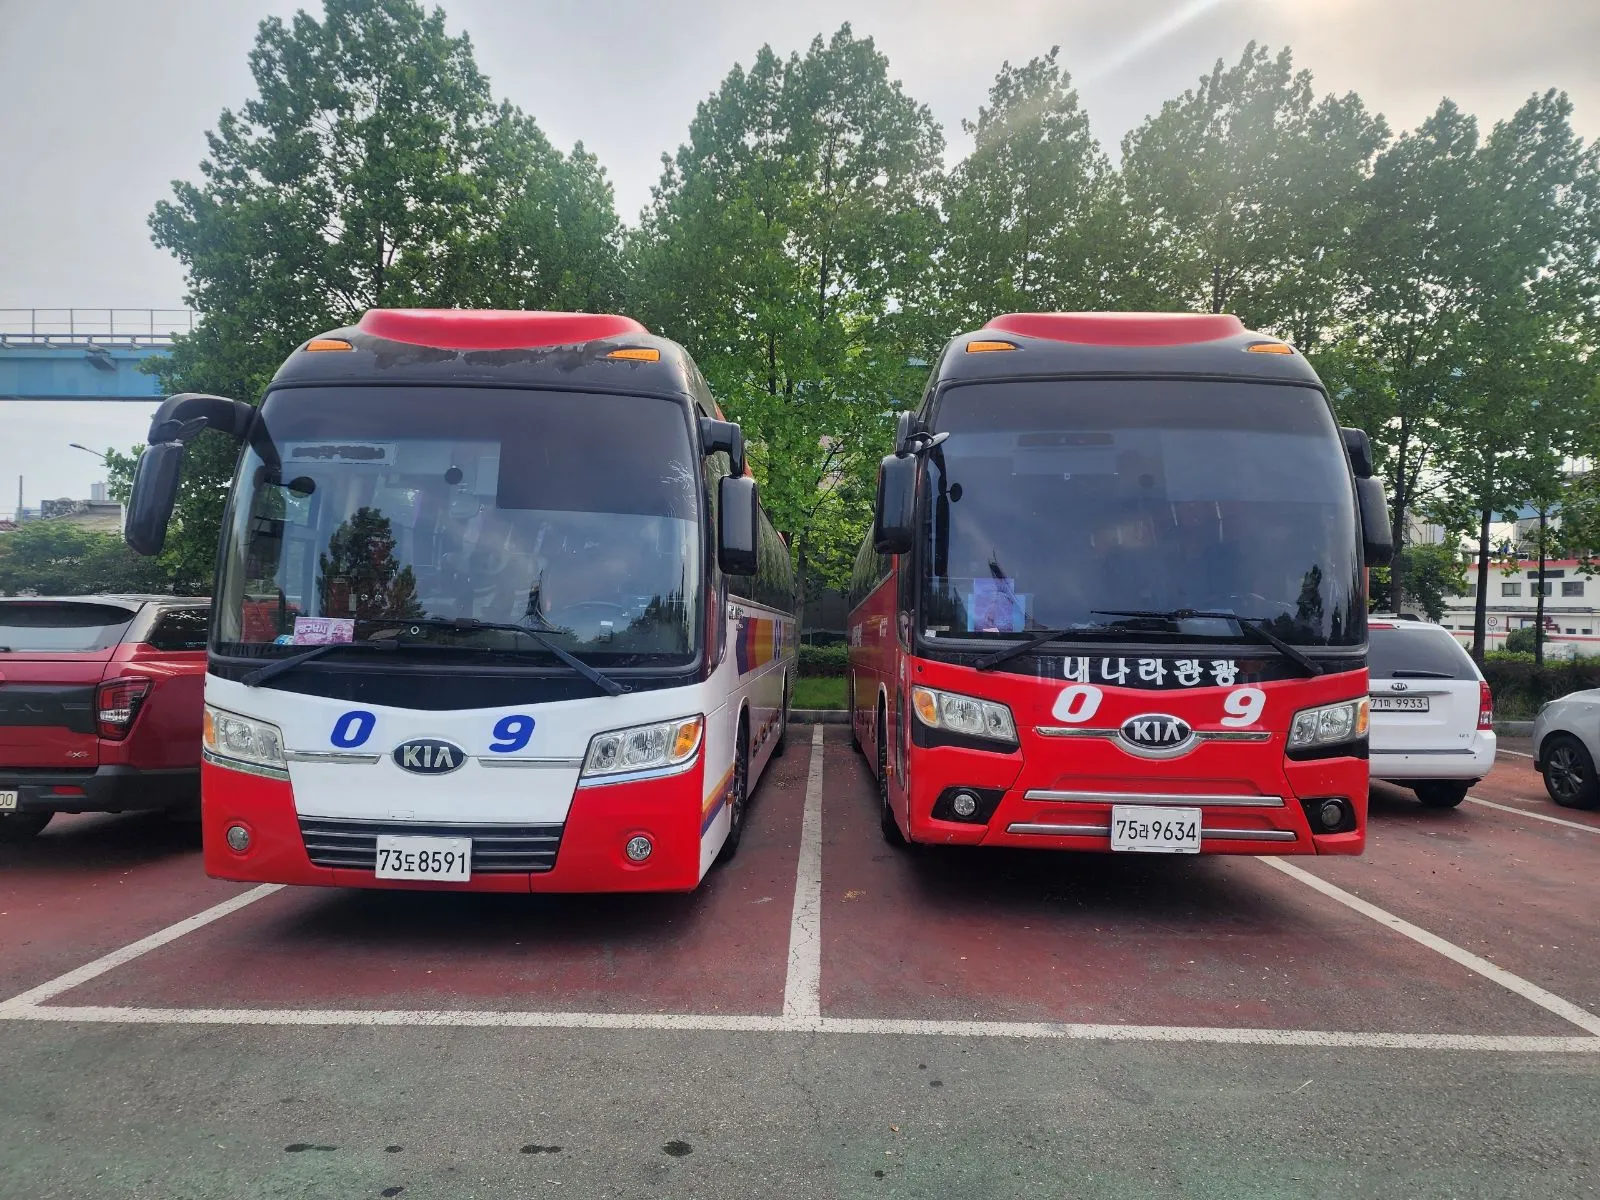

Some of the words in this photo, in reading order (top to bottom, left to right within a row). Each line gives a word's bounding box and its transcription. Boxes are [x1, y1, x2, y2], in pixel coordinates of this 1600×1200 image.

[1063, 656, 1240, 687] 내나라관광
[1051, 684, 1104, 723] 0
[1220, 687, 1267, 727] 9
[1396, 698, 1423, 709] 9933
[330, 710, 377, 749] 0
[488, 714, 536, 753] 9
[1132, 720, 1181, 743] KIA
[403, 745, 455, 768] KIA
[1116, 820, 1197, 842] 75라9634
[379, 849, 465, 874] 73도8591
